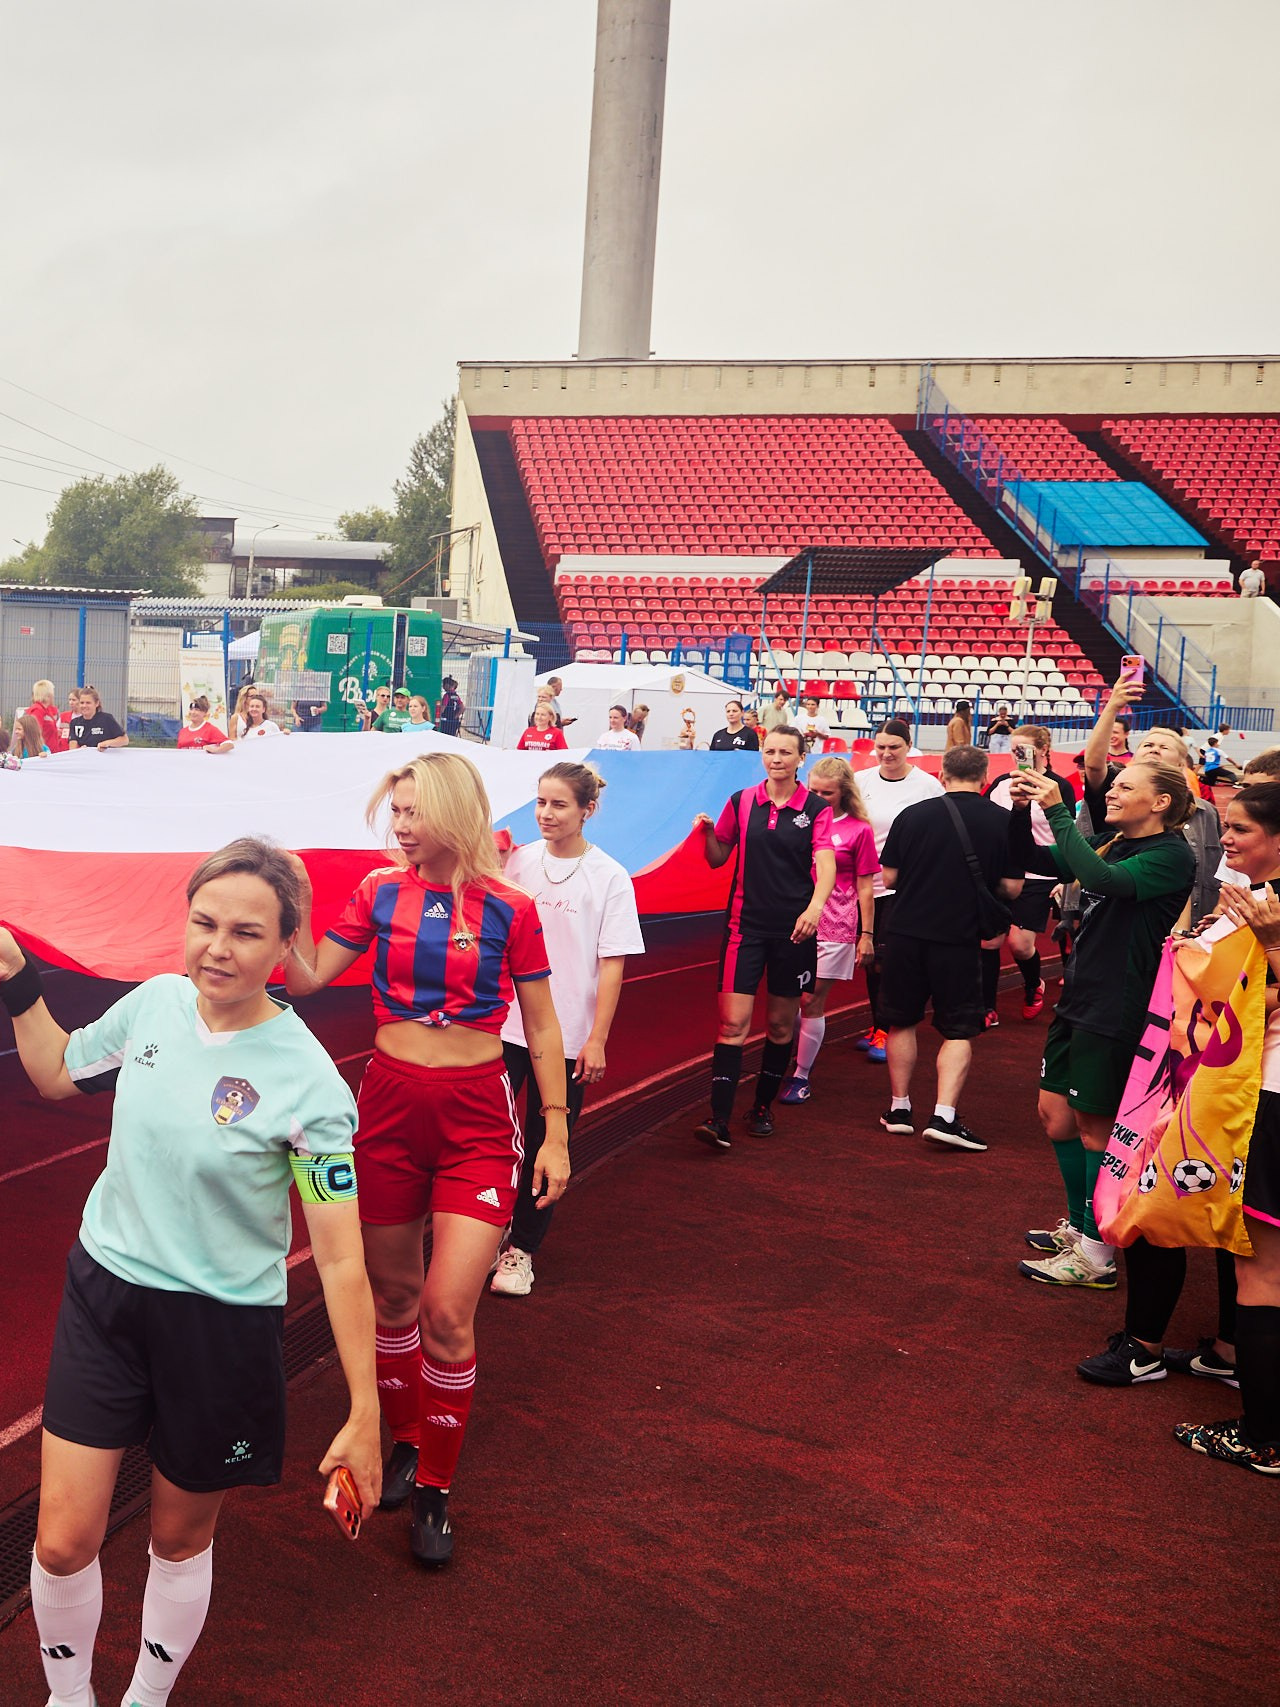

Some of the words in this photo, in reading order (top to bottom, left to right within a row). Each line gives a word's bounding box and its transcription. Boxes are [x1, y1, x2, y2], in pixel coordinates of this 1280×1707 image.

[424, 911, 449, 919] adidas
[134, 1056, 156, 1069] KELME
[1110, 1122, 1139, 1147] СКИЕ
[1100, 1151, 1130, 1181] ЕРЕД
[328, 1164, 353, 1191] C
[476, 1194, 500, 1208] adidas
[225, 1453, 253, 1464] KELME
